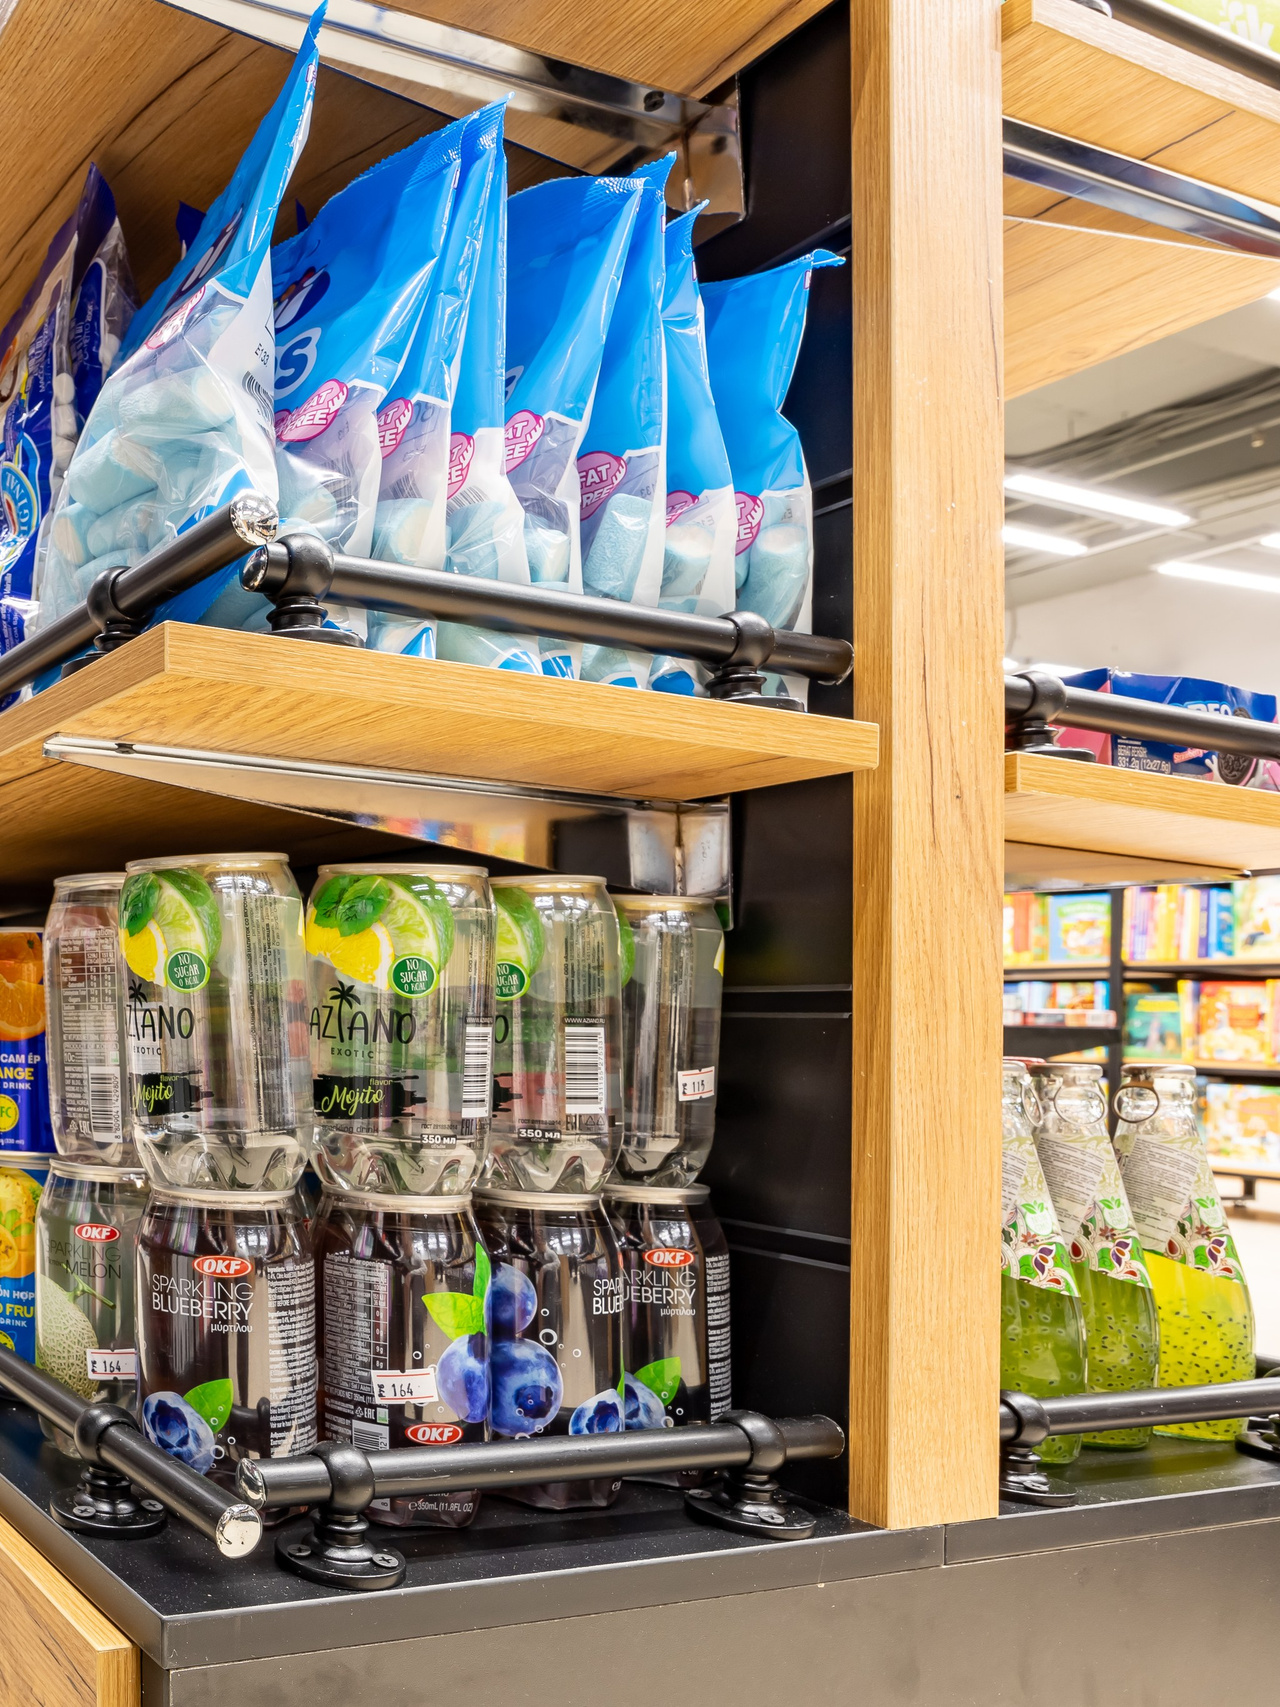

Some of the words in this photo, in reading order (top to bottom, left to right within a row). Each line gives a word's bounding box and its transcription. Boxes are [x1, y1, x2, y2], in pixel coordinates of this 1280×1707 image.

[178, 953, 190, 966] NO
[406, 959, 419, 970] NO
[174, 964, 200, 979] SUGAR
[497, 964, 509, 976] NO
[400, 971, 428, 983] SUGAR
[309, 1003, 417, 1046] AZIANO
[0, 1053, 25, 1064] CAM
[330, 1047, 375, 1059] EXOTIC
[3, 1081, 32, 1090] DRINK
[369, 1078, 393, 1086] flavor
[692, 1080, 705, 1092] 115
[132, 1083, 175, 1113] Mojito
[321, 1084, 385, 1117] Mojito
[356, 1124, 379, 1134] drink
[519, 1129, 543, 1138] 350
[545, 1130, 562, 1139] мл
[422, 1134, 441, 1144] 350
[442, 1136, 456, 1144] мл
[81, 1226, 111, 1240] OKF
[652, 1250, 685, 1265] OKF
[65, 1259, 122, 1279] MELON
[203, 1258, 241, 1274] OKF
[152, 1273, 254, 1301] SPARKLING
[152, 1292, 254, 1321] BLUEBERRY
[660, 1306, 696, 1318] μύρτιλου
[0, 1317, 28, 1328] DRINK
[210, 1320, 253, 1334] μύρτιλου
[103, 1360, 121, 1373] 164
[391, 1382, 414, 1397] 164
[417, 1426, 453, 1442] OKF
